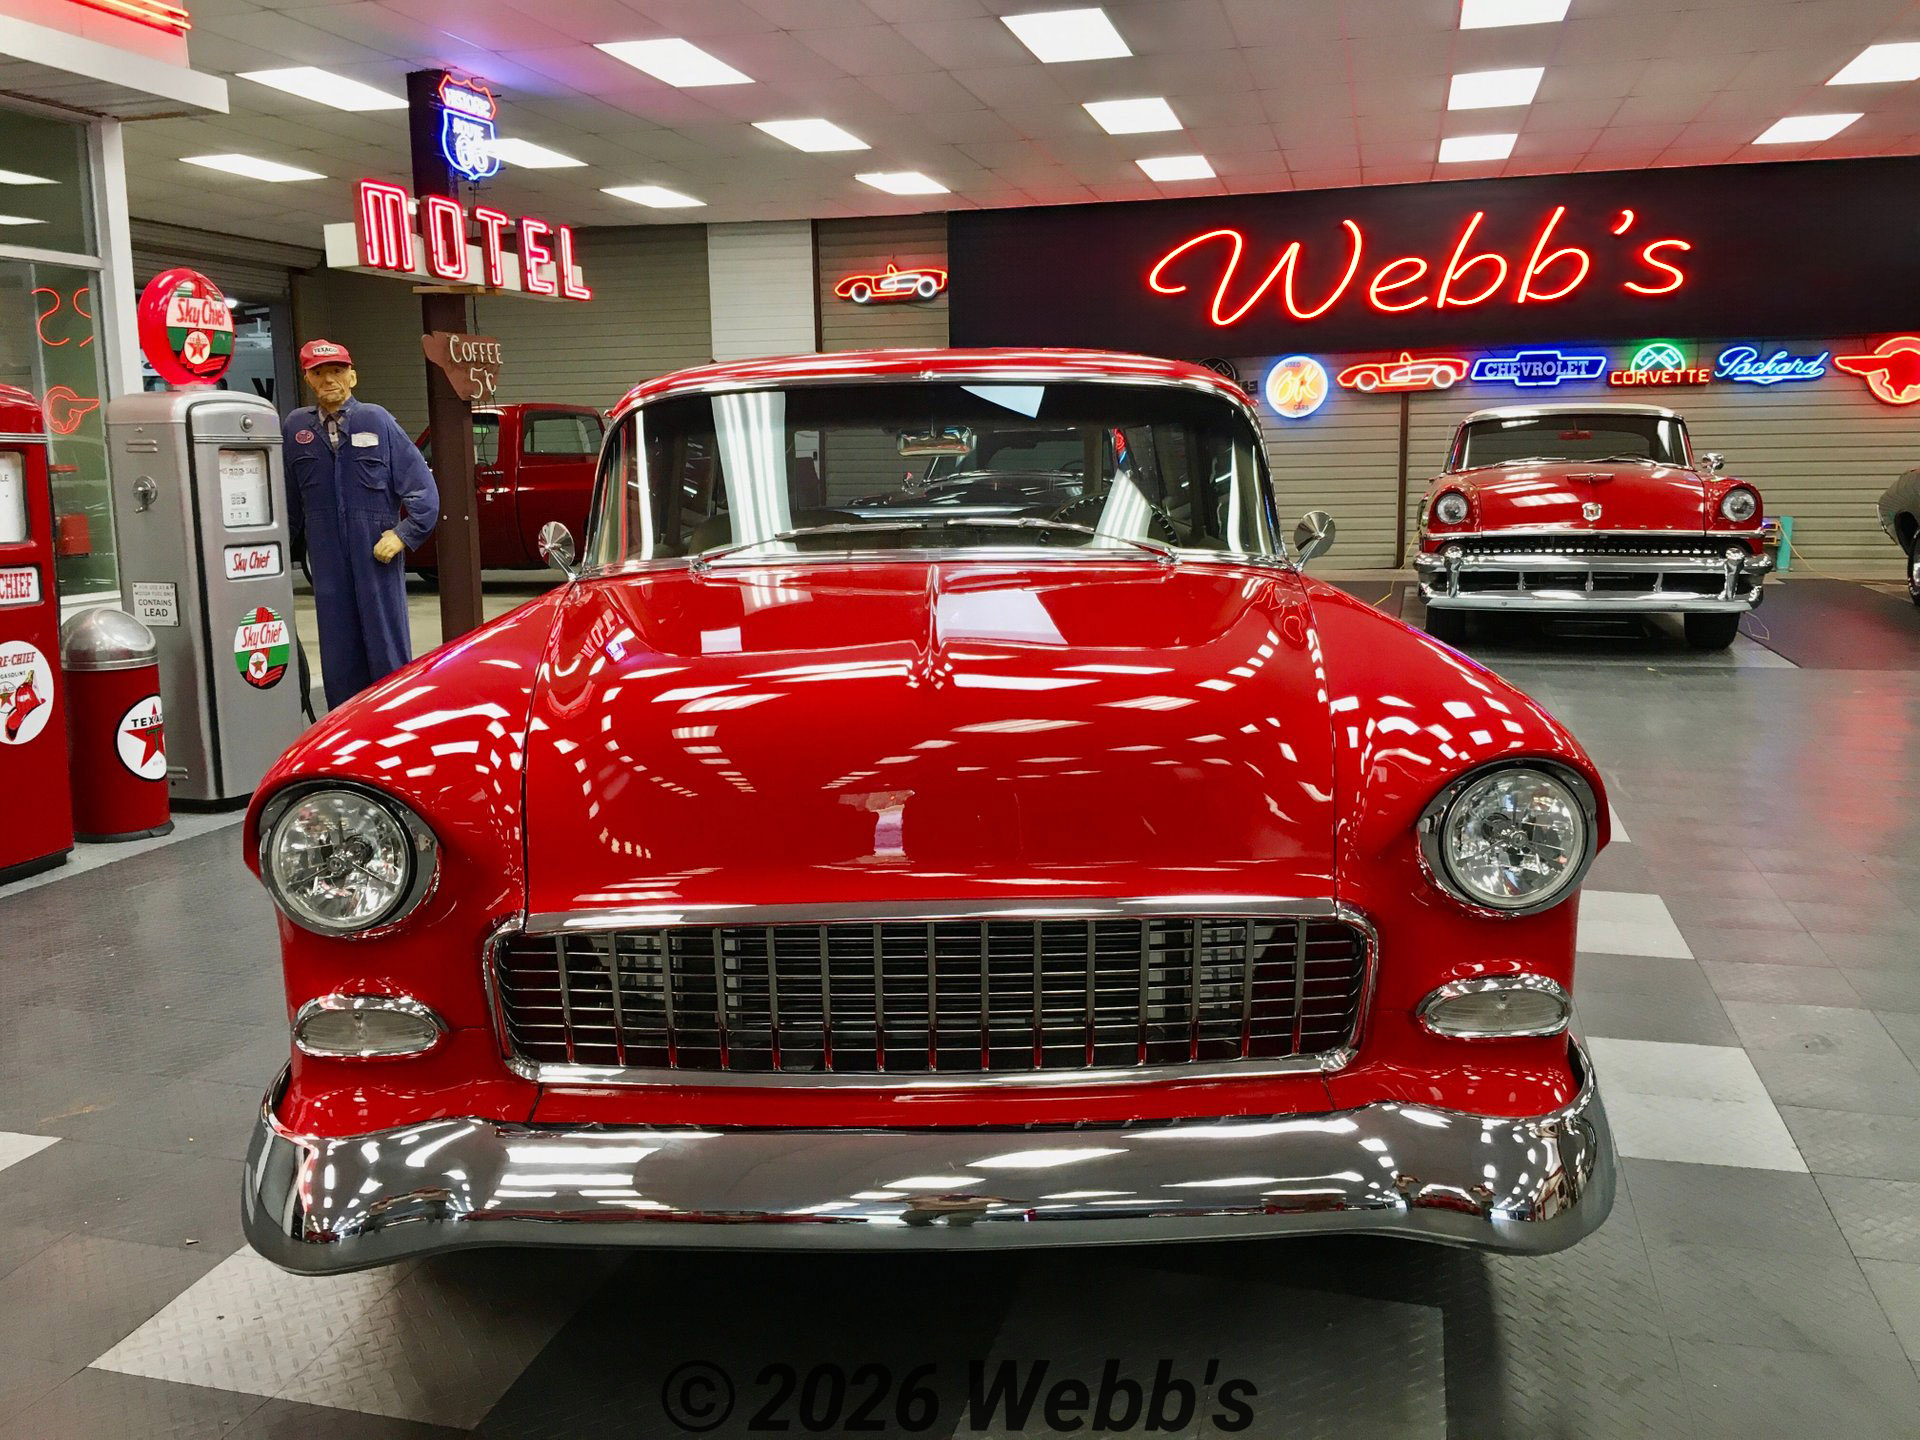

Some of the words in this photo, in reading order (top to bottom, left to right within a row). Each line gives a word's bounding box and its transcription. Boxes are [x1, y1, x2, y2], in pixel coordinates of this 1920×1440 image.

[355, 178, 593, 300] MOTEL
[1149, 206, 1692, 325] Webb's
[176, 299, 200, 327] Sky
[201, 300, 226, 326] Chief
[450, 335, 504, 364] COFFEE
[1714, 346, 1829, 379] Packard
[1484, 360, 1590, 377] CHEVROLET
[1610, 368, 1710, 385] CORVETTE
[1276, 363, 1319, 405] OK
[233, 553, 247, 573] Sky
[249, 551, 271, 570] Chief
[0, 572, 32, 599] CHIEF
[144, 608, 168, 617] LEAD
[242, 626, 259, 649] Sky
[260, 622, 283, 644] Chief
